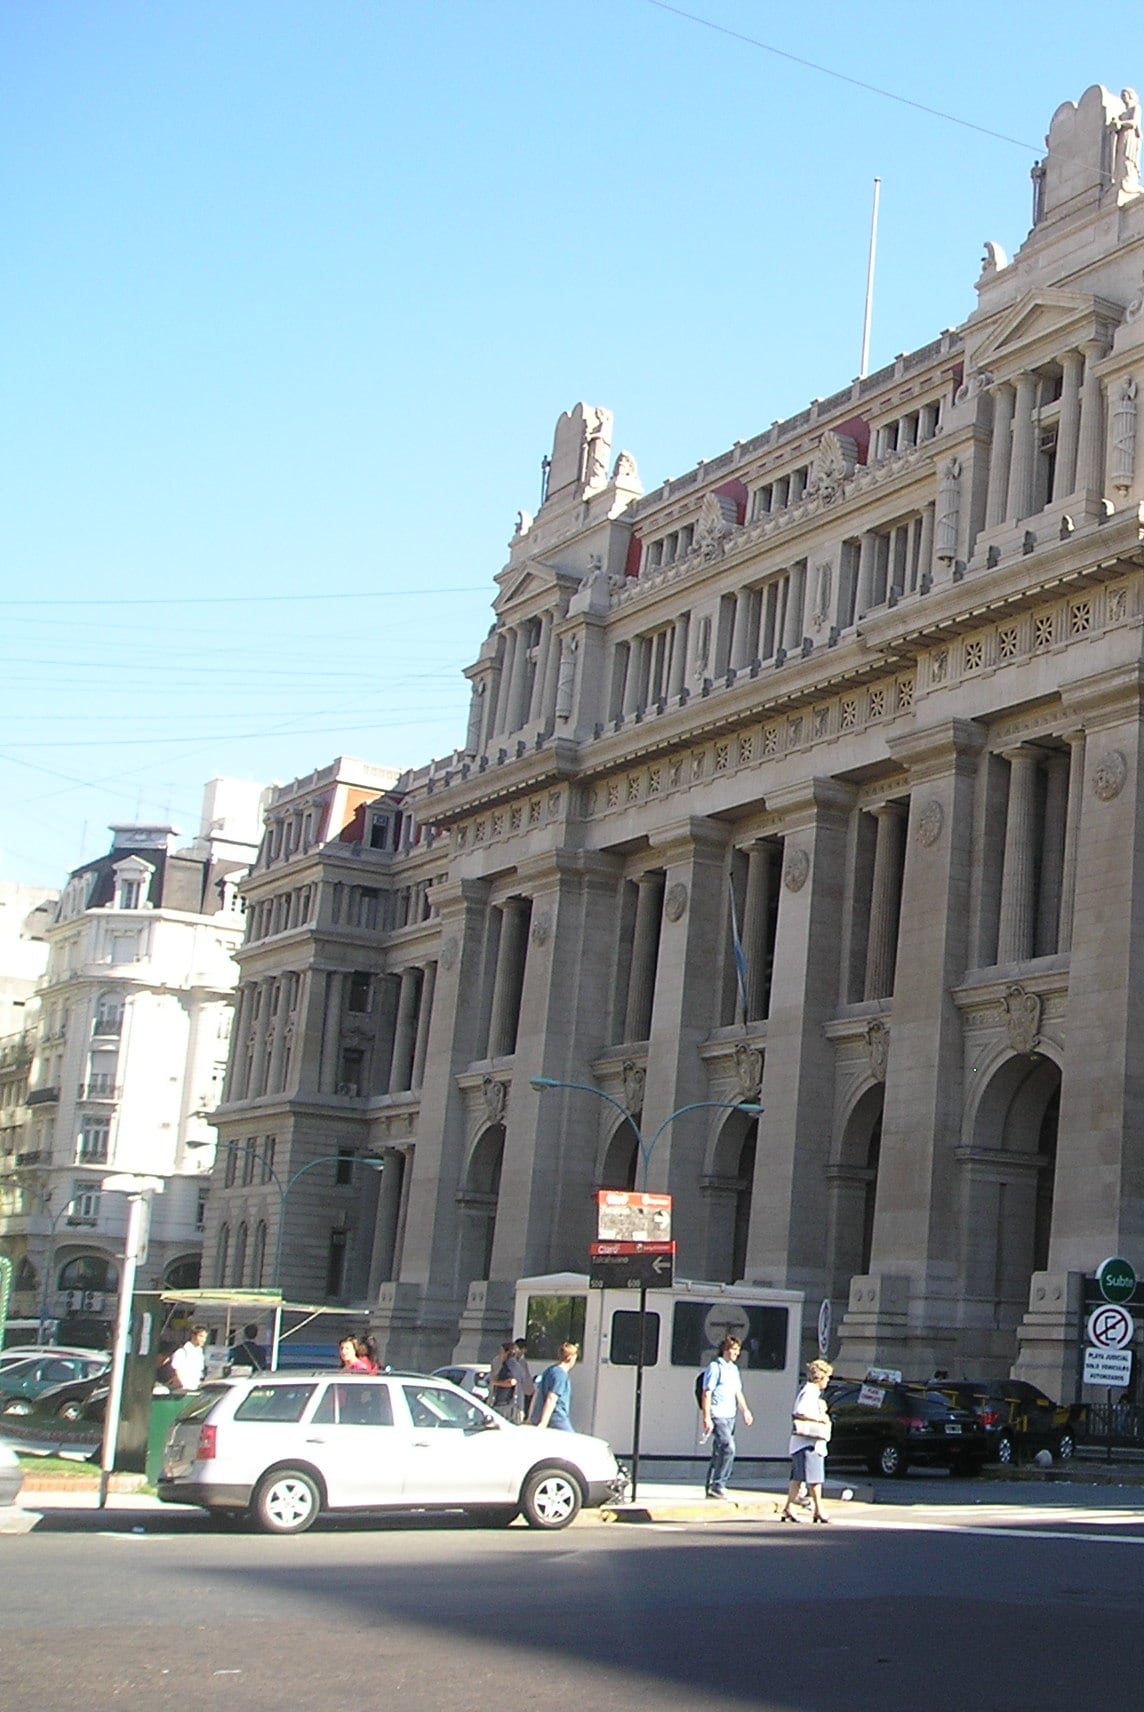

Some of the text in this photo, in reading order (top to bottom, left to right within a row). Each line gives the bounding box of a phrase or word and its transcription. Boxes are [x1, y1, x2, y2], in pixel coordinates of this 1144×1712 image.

[1106, 1274, 1134, 1288] Subte
[1088, 1352, 1128, 1362] PLAYA JUDICIAL
[1089, 1373, 1124, 1382] AUTORIZADOS
